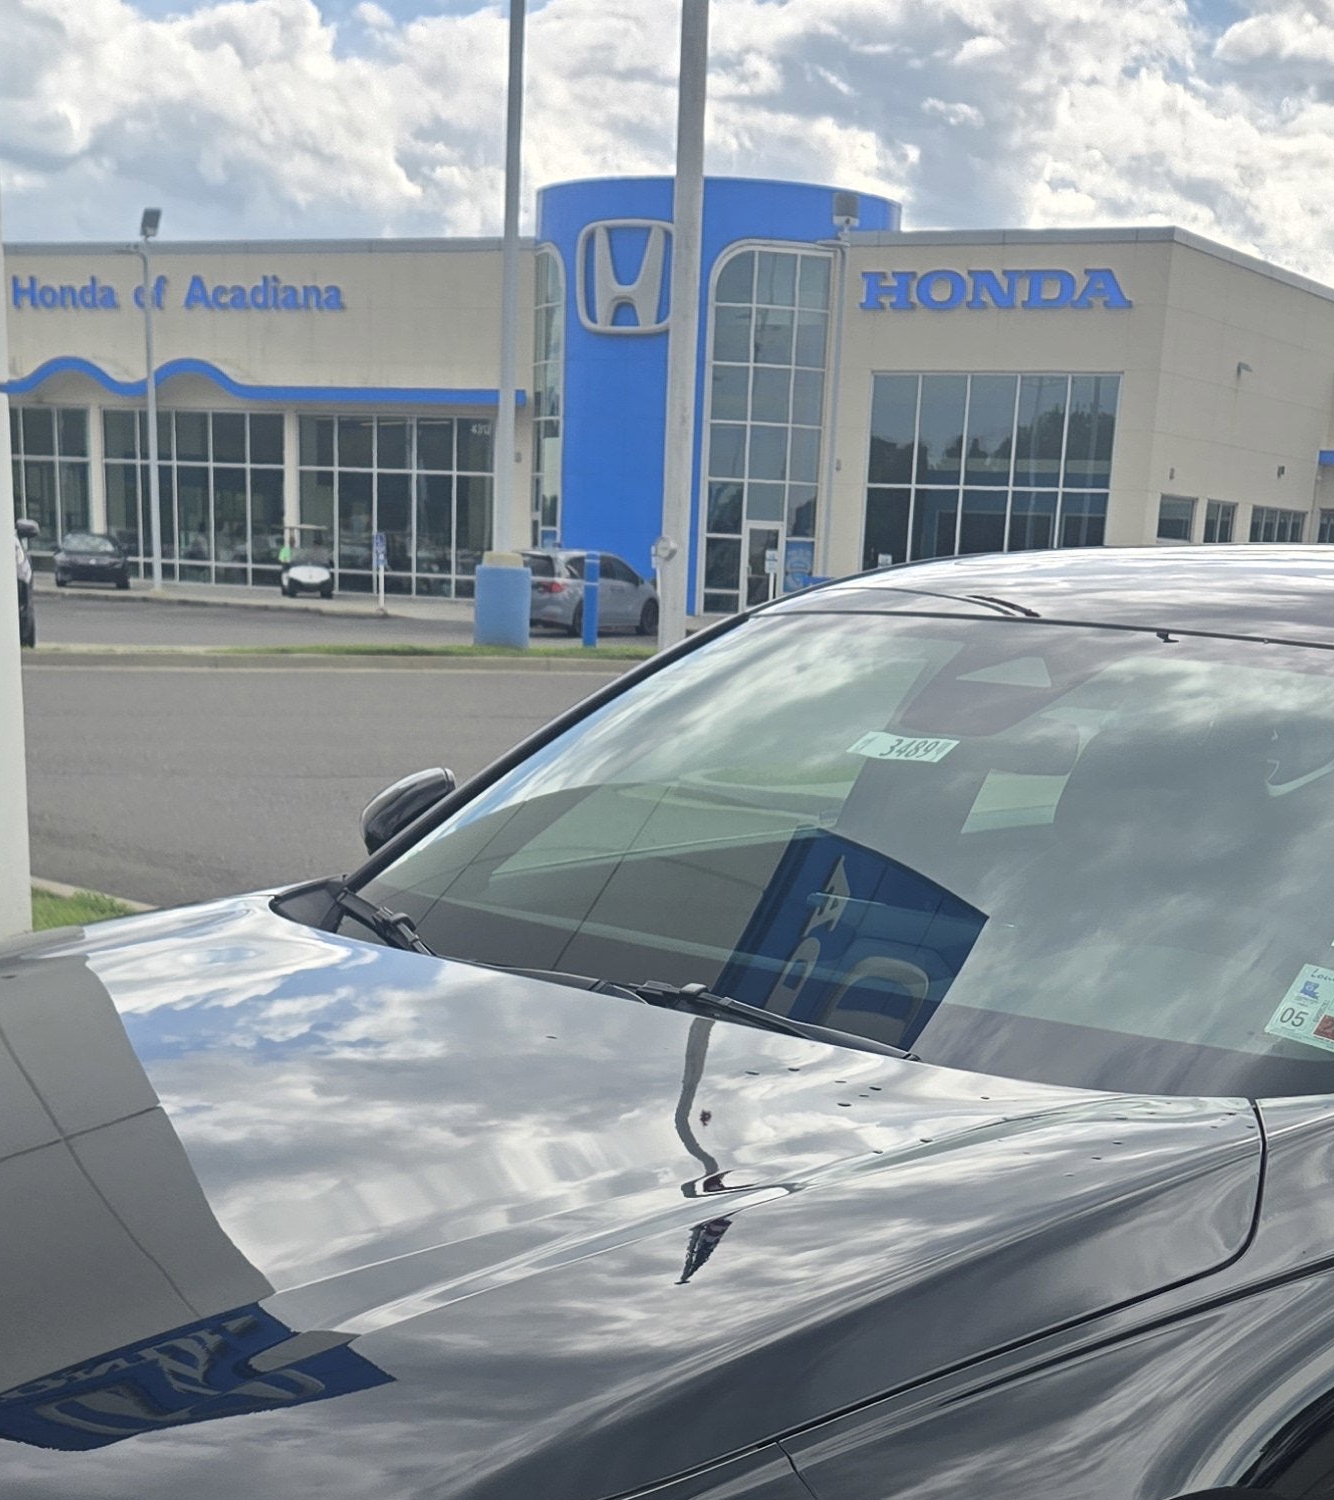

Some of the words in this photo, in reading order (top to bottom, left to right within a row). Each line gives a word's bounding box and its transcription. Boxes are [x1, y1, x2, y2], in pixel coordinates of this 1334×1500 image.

[11, 274, 117, 310] Honda
[184, 274, 344, 311] Acadiana
[859, 268, 1133, 310] HONDA
[879, 739, 940, 758] 3489
[1279, 1007, 1309, 1028] 05
